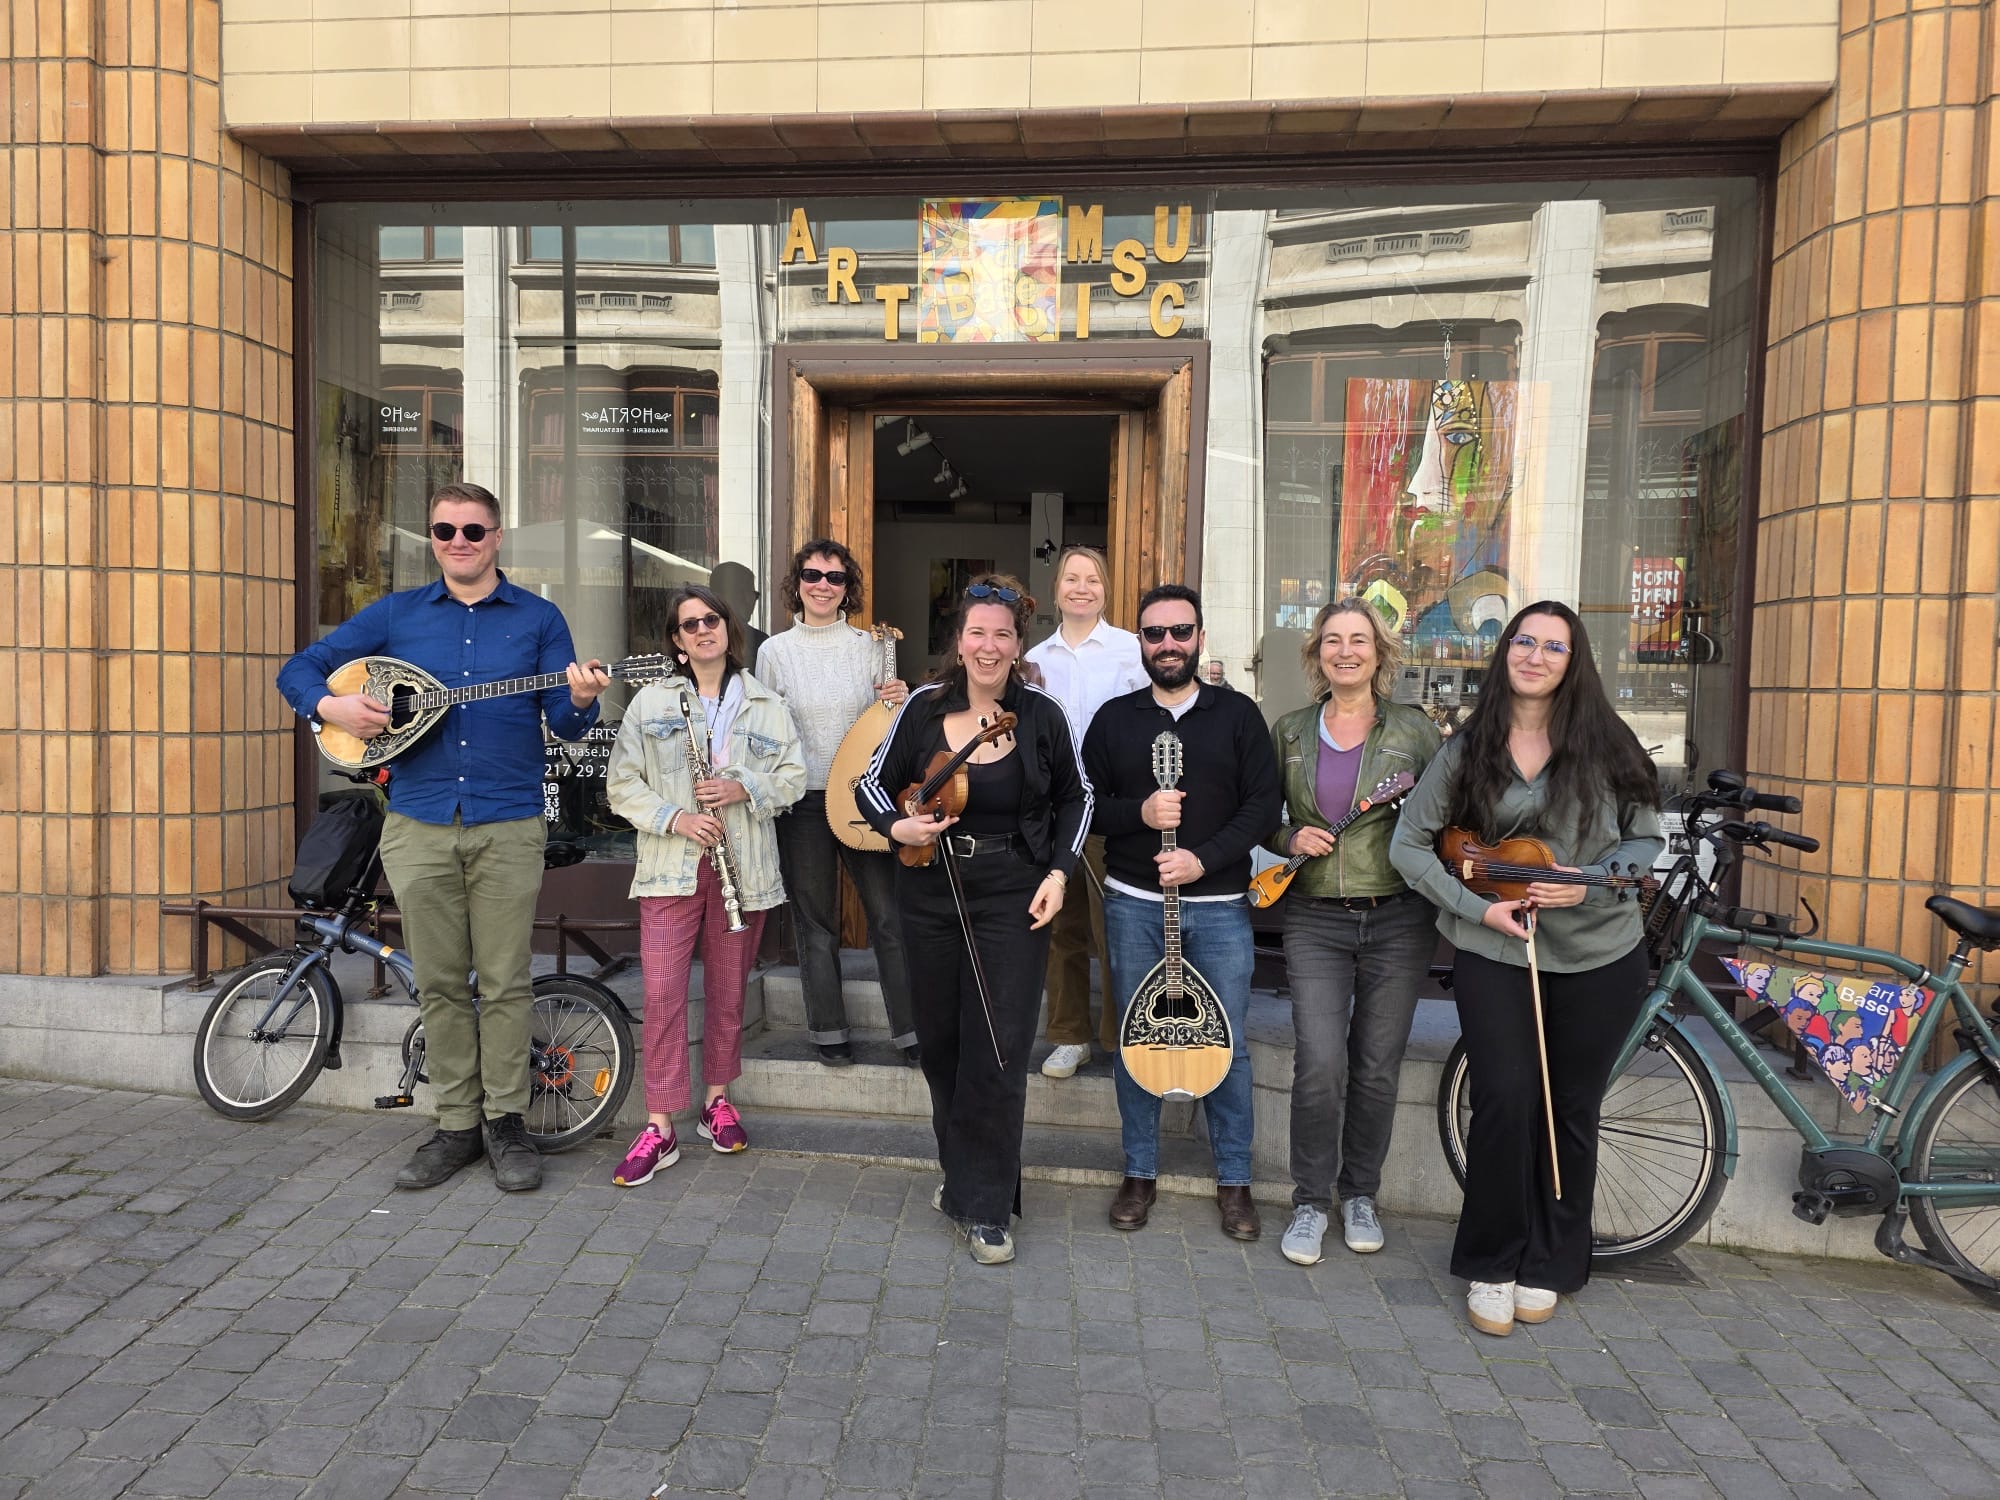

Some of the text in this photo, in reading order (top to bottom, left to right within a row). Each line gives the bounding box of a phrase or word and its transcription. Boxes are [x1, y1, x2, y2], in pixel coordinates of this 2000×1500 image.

[782, 207, 908, 340] ART
[545, 745, 610, 757] art-base.b
[545, 763, 607, 778] 217 29 2
[1839, 986, 1890, 1016] Base
[1868, 984, 1896, 1004] art
[1713, 1012, 1773, 1081] GAZELLE
